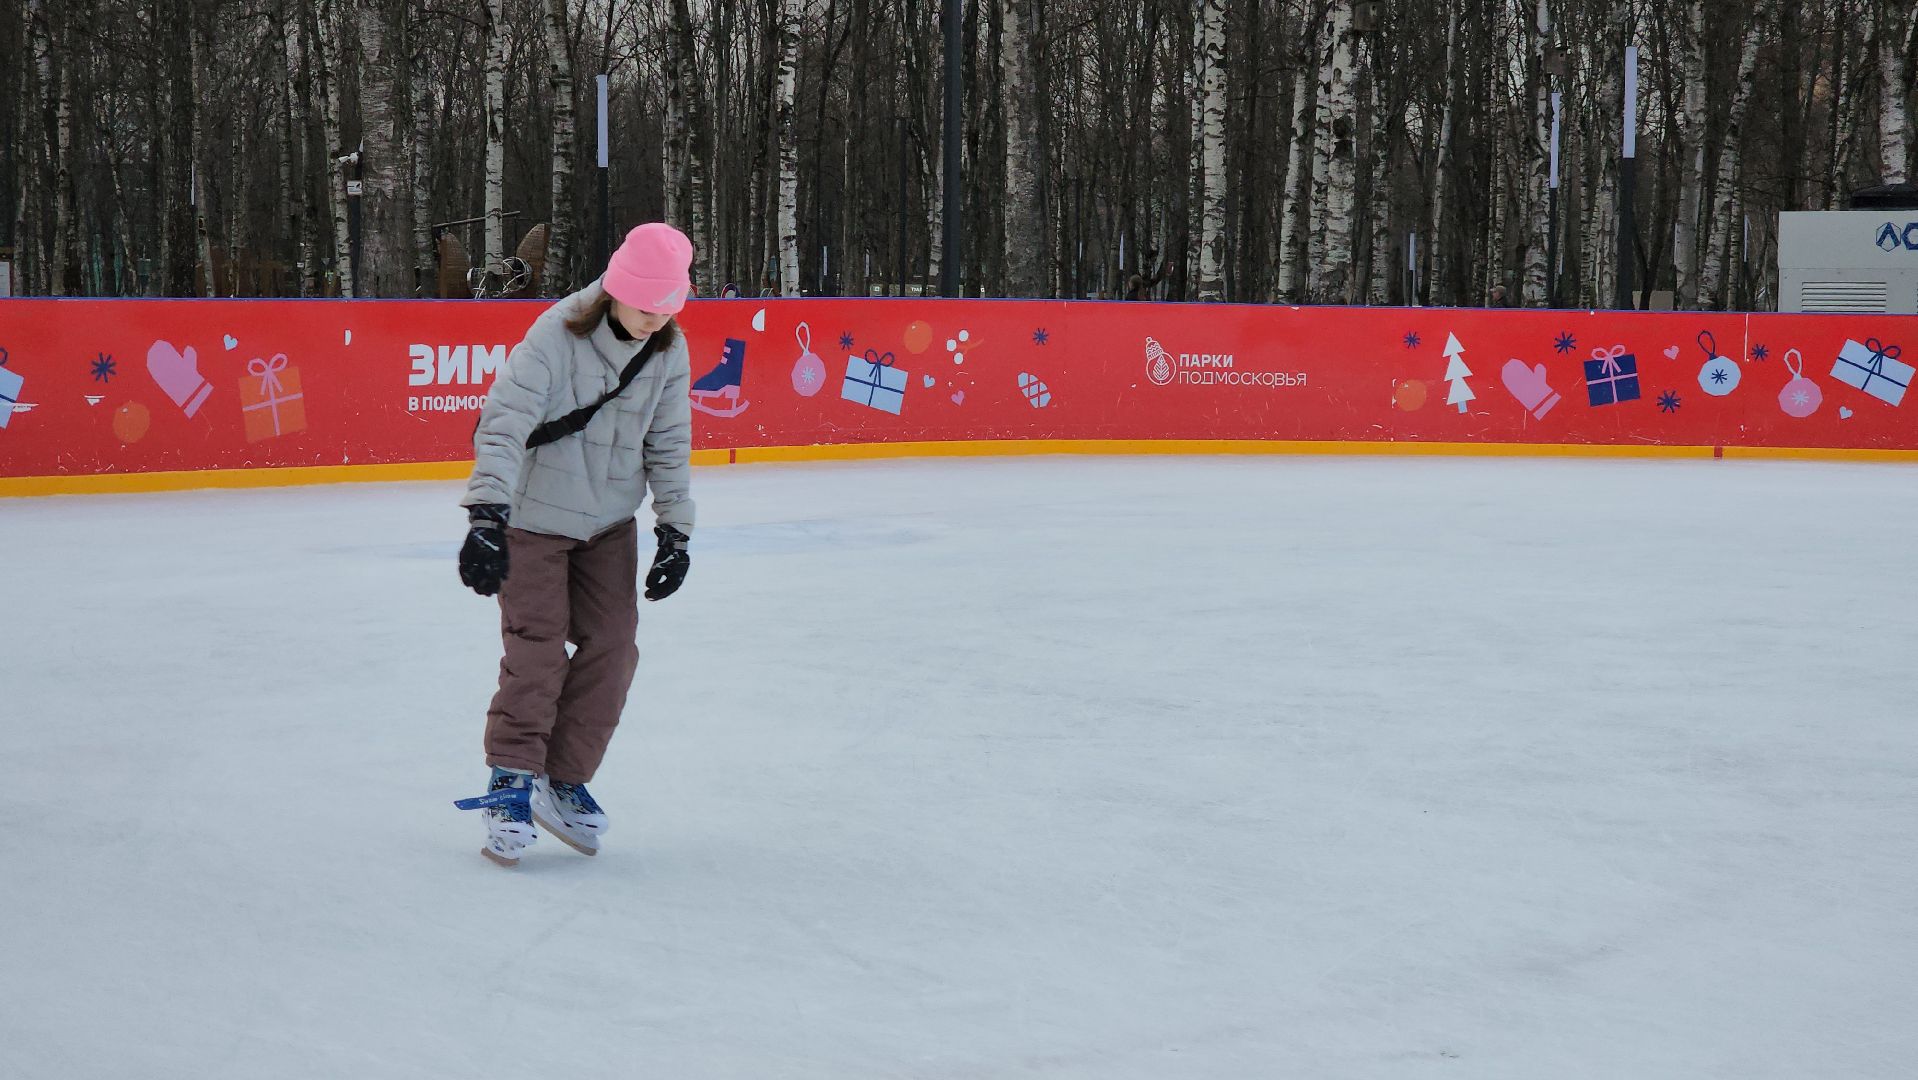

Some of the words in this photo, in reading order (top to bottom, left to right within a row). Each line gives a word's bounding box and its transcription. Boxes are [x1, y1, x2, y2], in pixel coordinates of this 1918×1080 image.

[408, 344, 506, 386] ЗИМ
[1179, 354, 1233, 368] ПАРКИ
[1179, 371, 1307, 386] ПОДМОСКОВЬЯ
[408, 396, 419, 411] В
[422, 395, 488, 412] ПОДМОС
